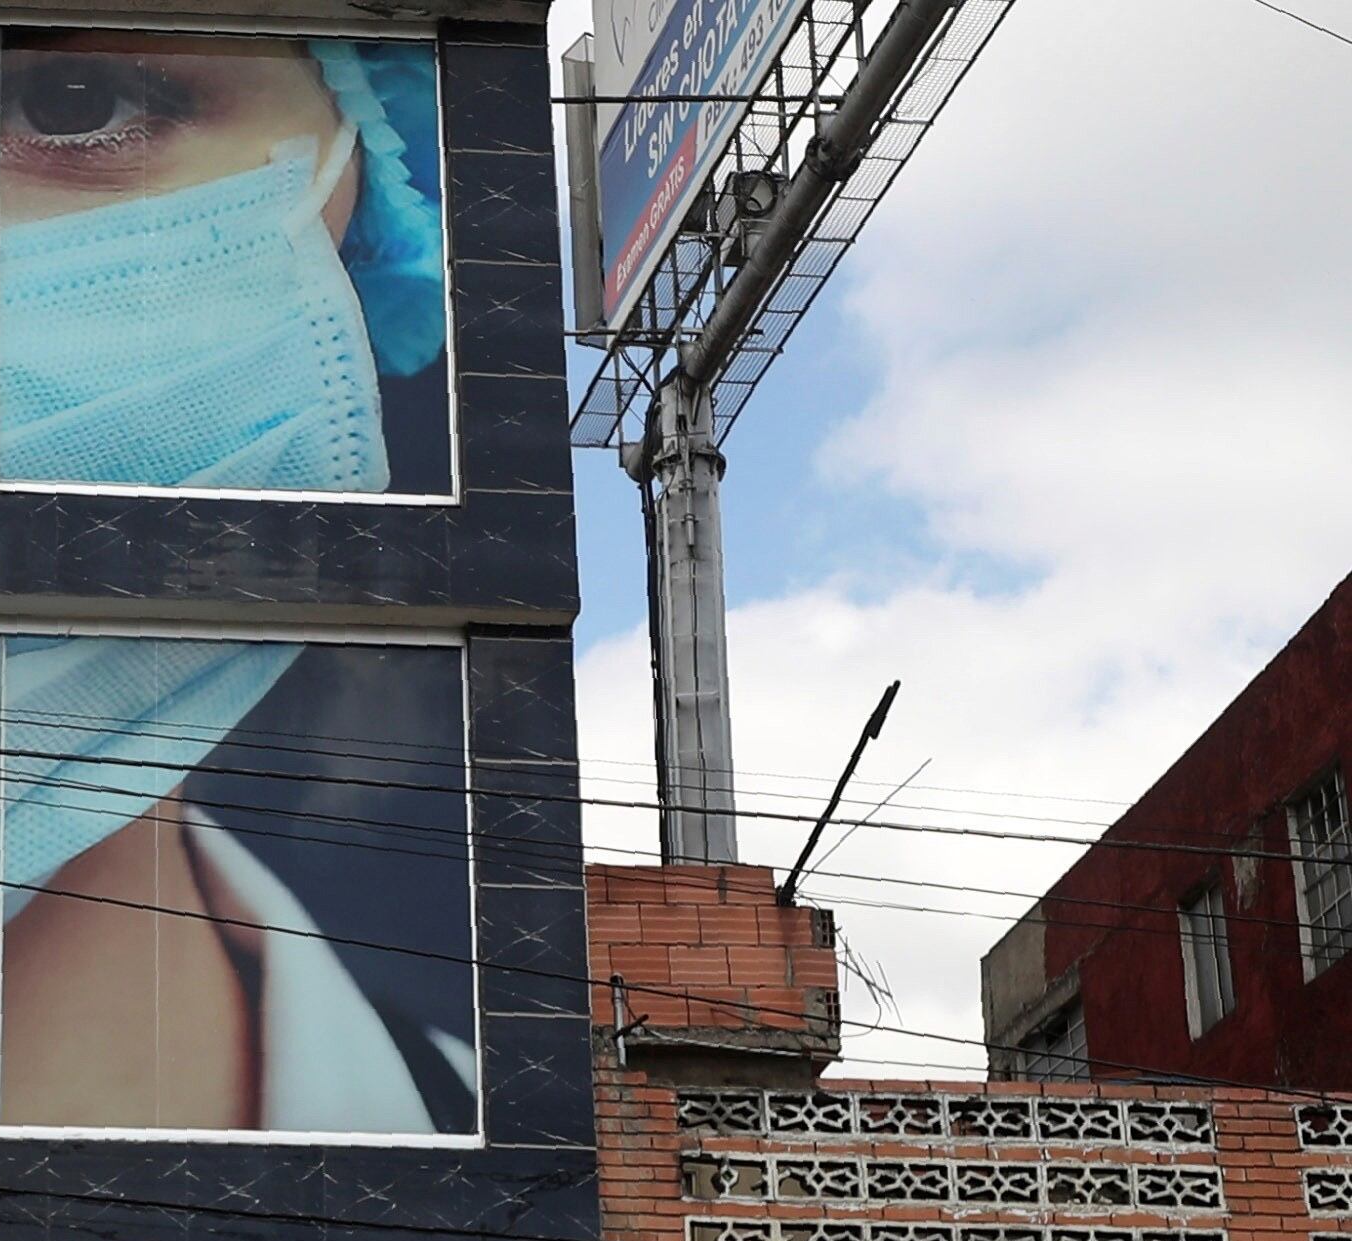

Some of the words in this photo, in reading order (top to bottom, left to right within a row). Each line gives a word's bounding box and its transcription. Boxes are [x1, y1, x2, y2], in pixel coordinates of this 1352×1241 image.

[648, 100, 674, 179] SIN
[679, 0, 737, 122] CUOTA
[741, 14, 764, 71] 493
[616, 223, 650, 292] Examen
[650, 156, 685, 229] GRATIS
